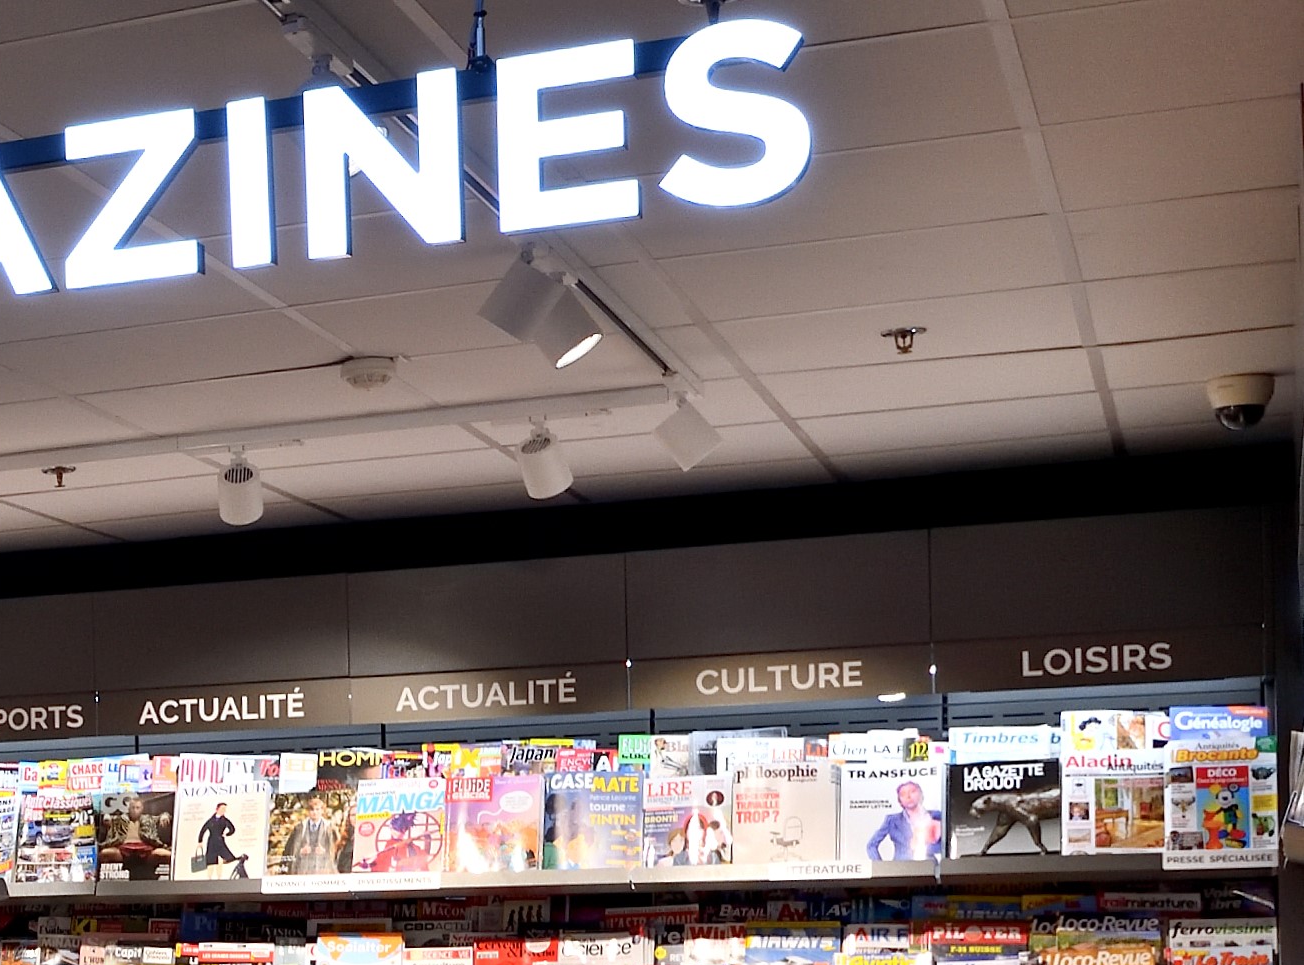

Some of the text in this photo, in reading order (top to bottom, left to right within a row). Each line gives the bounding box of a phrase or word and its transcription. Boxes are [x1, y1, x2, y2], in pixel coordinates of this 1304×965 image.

[1021, 642, 1173, 678] LOISIRS
[695, 660, 864, 696] CULTURE
[396, 671, 577, 712] ACTUALITÉ
[139, 686, 306, 726] ACTUALITÉ
[1173, 710, 1264, 733] Généalogie
[961, 730, 1040, 747] Timbres
[1065, 754, 1133, 771] Aladin
[1174, 746, 1259, 764] Brocante
[964, 777, 1022, 792] DROUOT
[357, 791, 446, 814] MANGA
[1165, 852, 1274, 867] PRESSE SPÉCIALISÉE
[326, 939, 392, 954] Socialter
